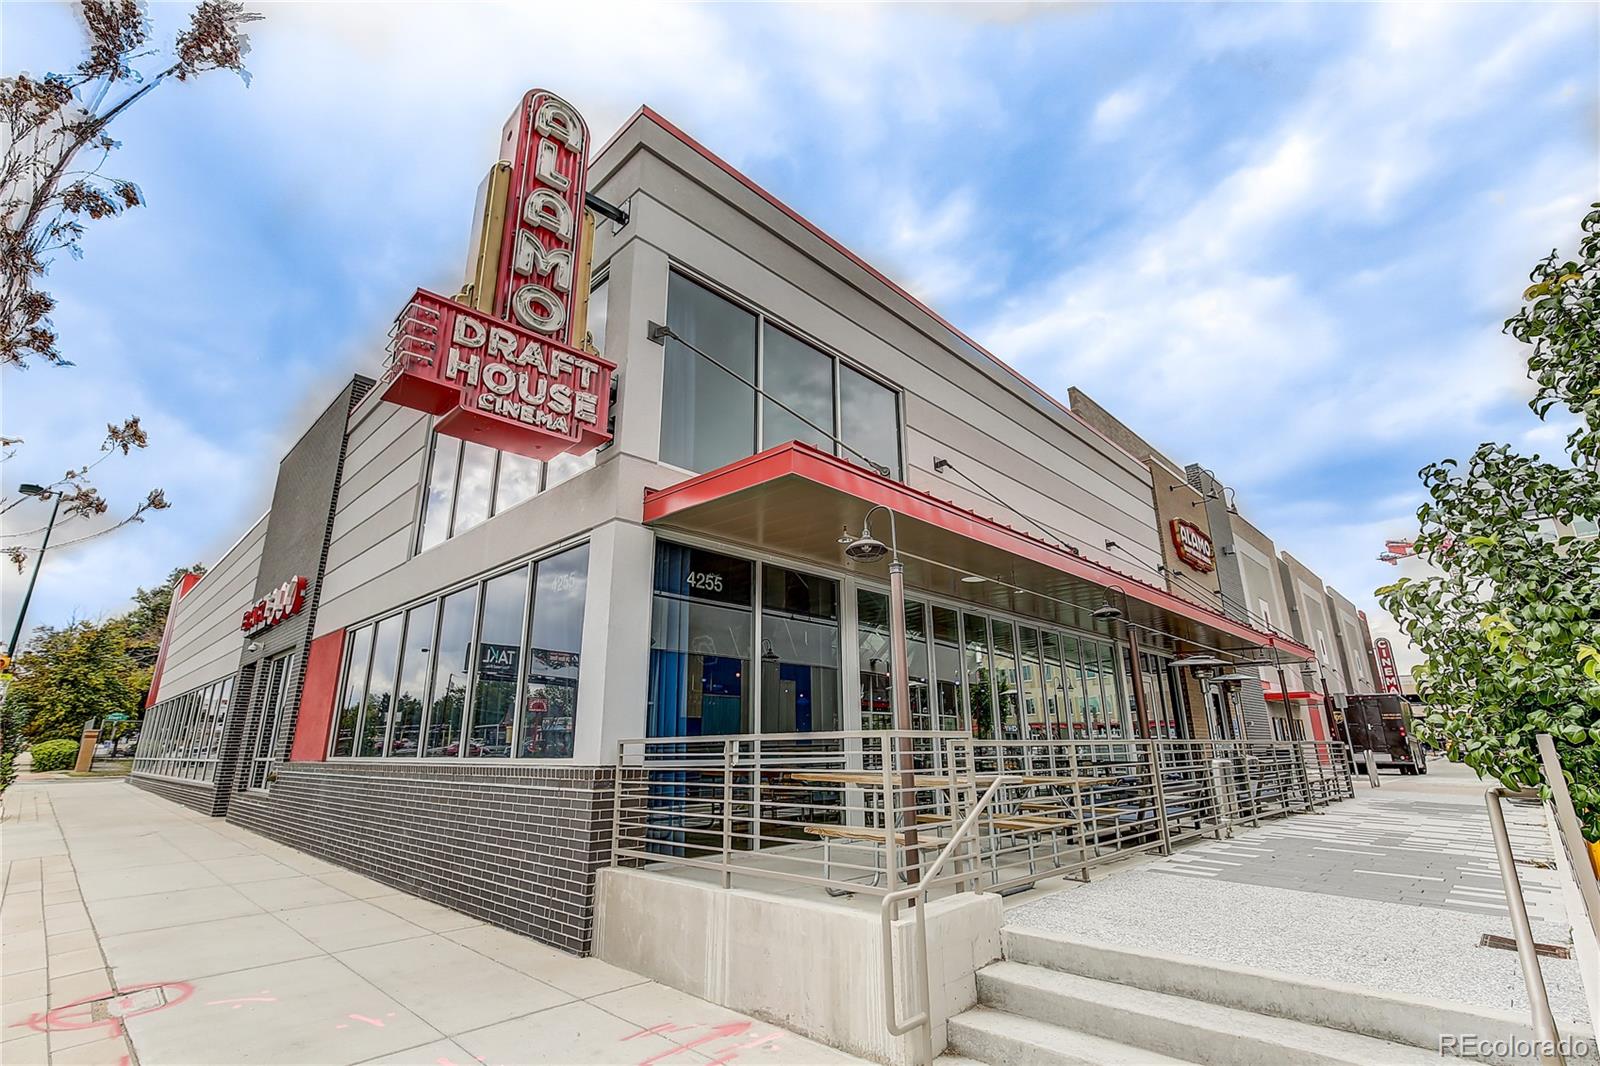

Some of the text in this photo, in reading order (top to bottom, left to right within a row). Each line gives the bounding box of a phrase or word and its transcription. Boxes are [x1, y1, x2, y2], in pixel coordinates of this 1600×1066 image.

[512, 99, 583, 335] ALAMO
[452, 313, 600, 389] DRAFT
[445, 346, 599, 425] HOUSE
[477, 393, 570, 434] CINEMA
[1180, 525, 1211, 557] ALAMO
[686, 571, 723, 592] 4255
[1377, 640, 1399, 694] CINEMA
